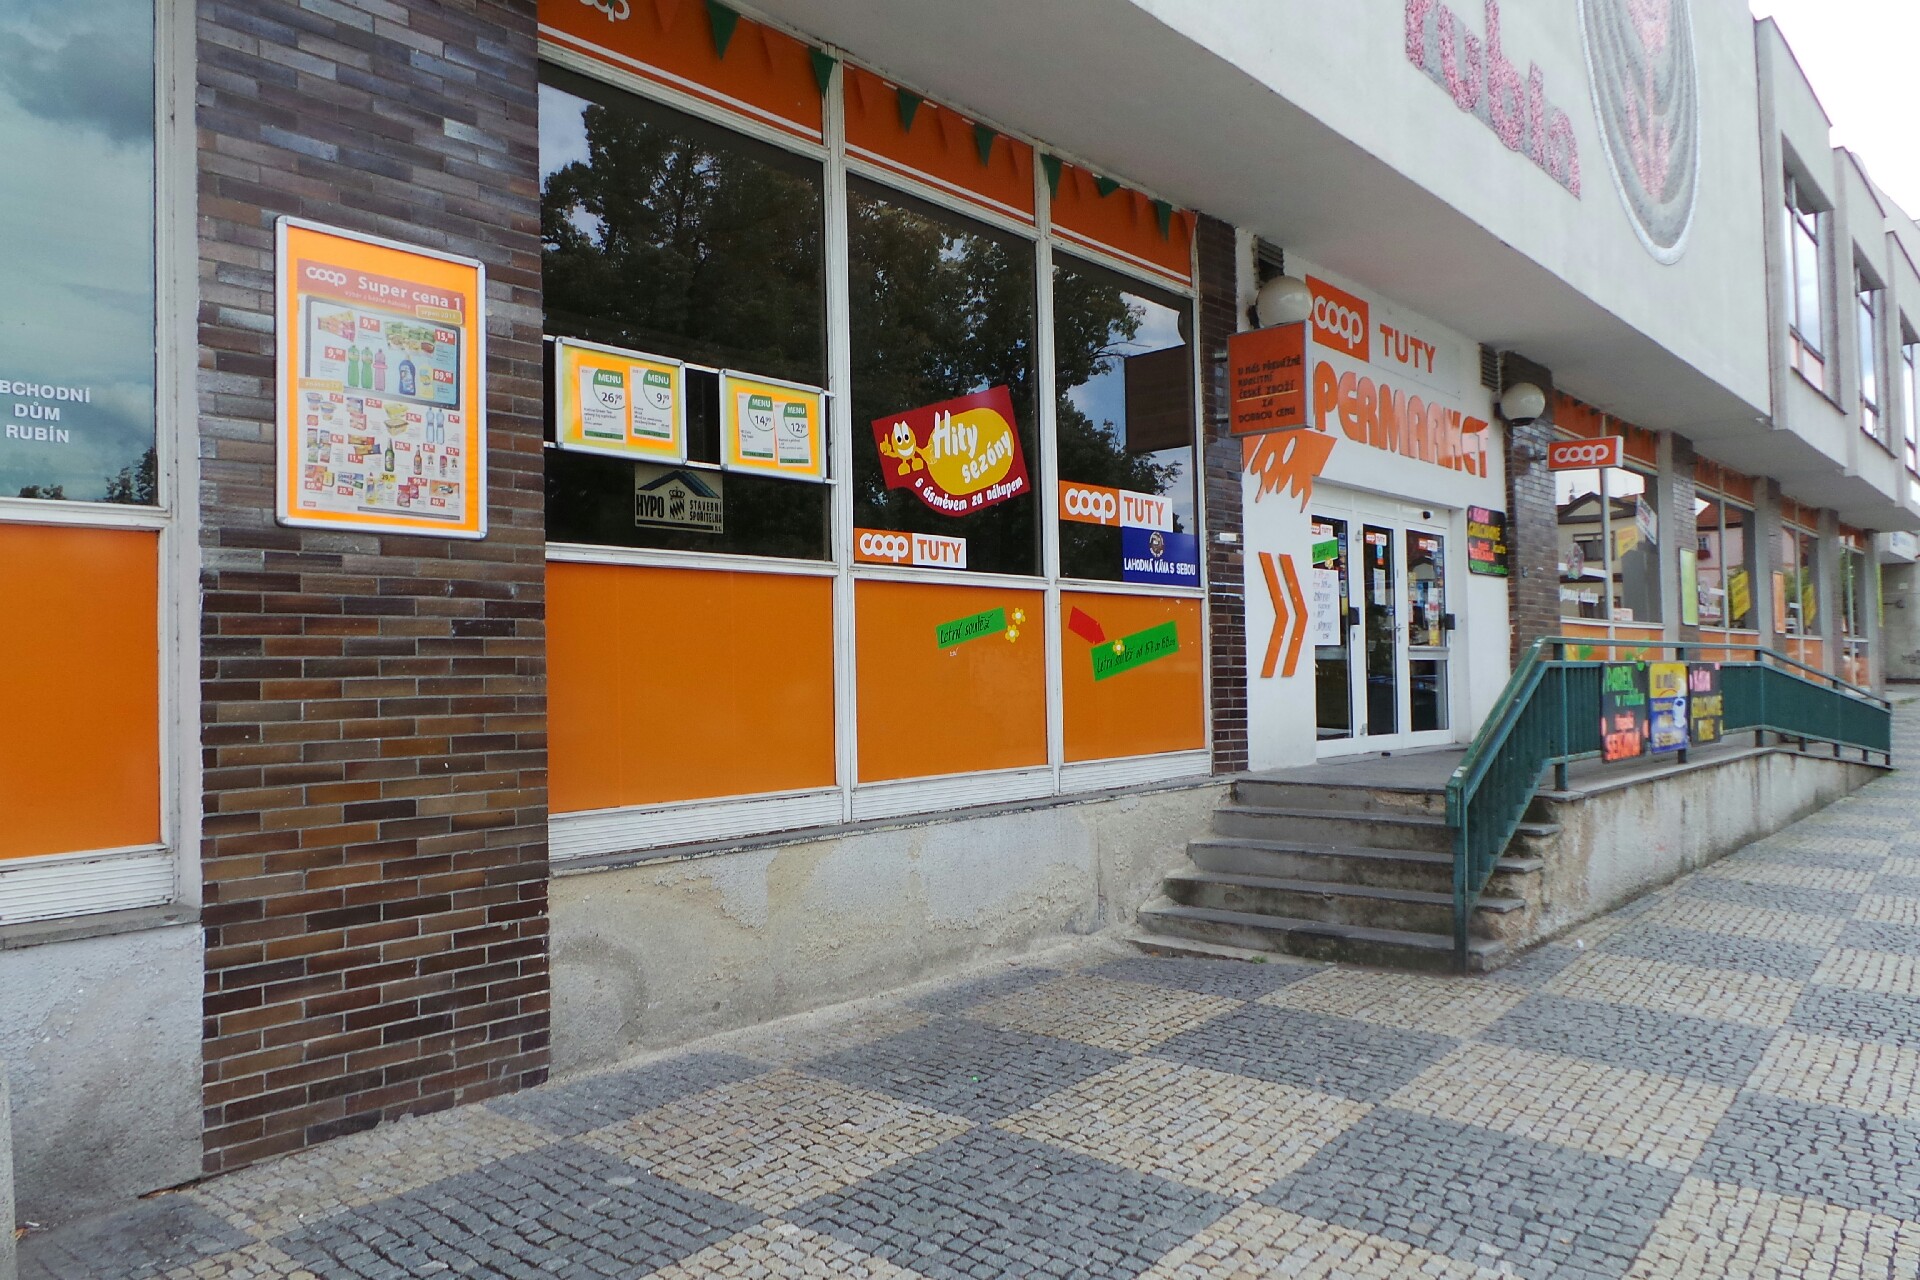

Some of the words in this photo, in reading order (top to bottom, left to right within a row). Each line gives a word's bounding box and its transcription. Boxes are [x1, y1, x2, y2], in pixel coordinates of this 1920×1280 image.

[306, 266, 347, 286] coop
[358, 276, 407, 298] Super
[412, 291, 448, 307] cena
[454, 297, 460, 310] 1
[1314, 295, 1363, 349] coop
[1380, 323, 1436, 374] TUTY
[598, 373, 621, 384] MENU
[647, 373, 669, 384] MENU
[14, 402, 60, 421] DŮM
[752, 398, 771, 408] MENU
[787, 406, 805, 414] MENU
[5, 424, 70, 443] RUBÍN
[933, 409, 978, 459] Hity
[962, 431, 1012, 484] sezóny
[1554, 444, 1609, 464] coop
[923, 486, 967, 511] úsměvem
[972, 493, 982, 506] za
[986, 476, 1023, 498] nákupem
[636, 494, 665, 518] HYPO
[690, 499, 722, 512] STAVEBNÍ
[1065, 487, 1117, 524] coop
[1124, 497, 1165, 526] TUTY
[860, 532, 909, 563] coop
[917, 538, 963, 563] TUTY
[1124, 557, 1153, 573] LAHODNÁ
[1154, 559, 1169, 574] KÁVA
[1176, 562, 1195, 576] SEBOU
